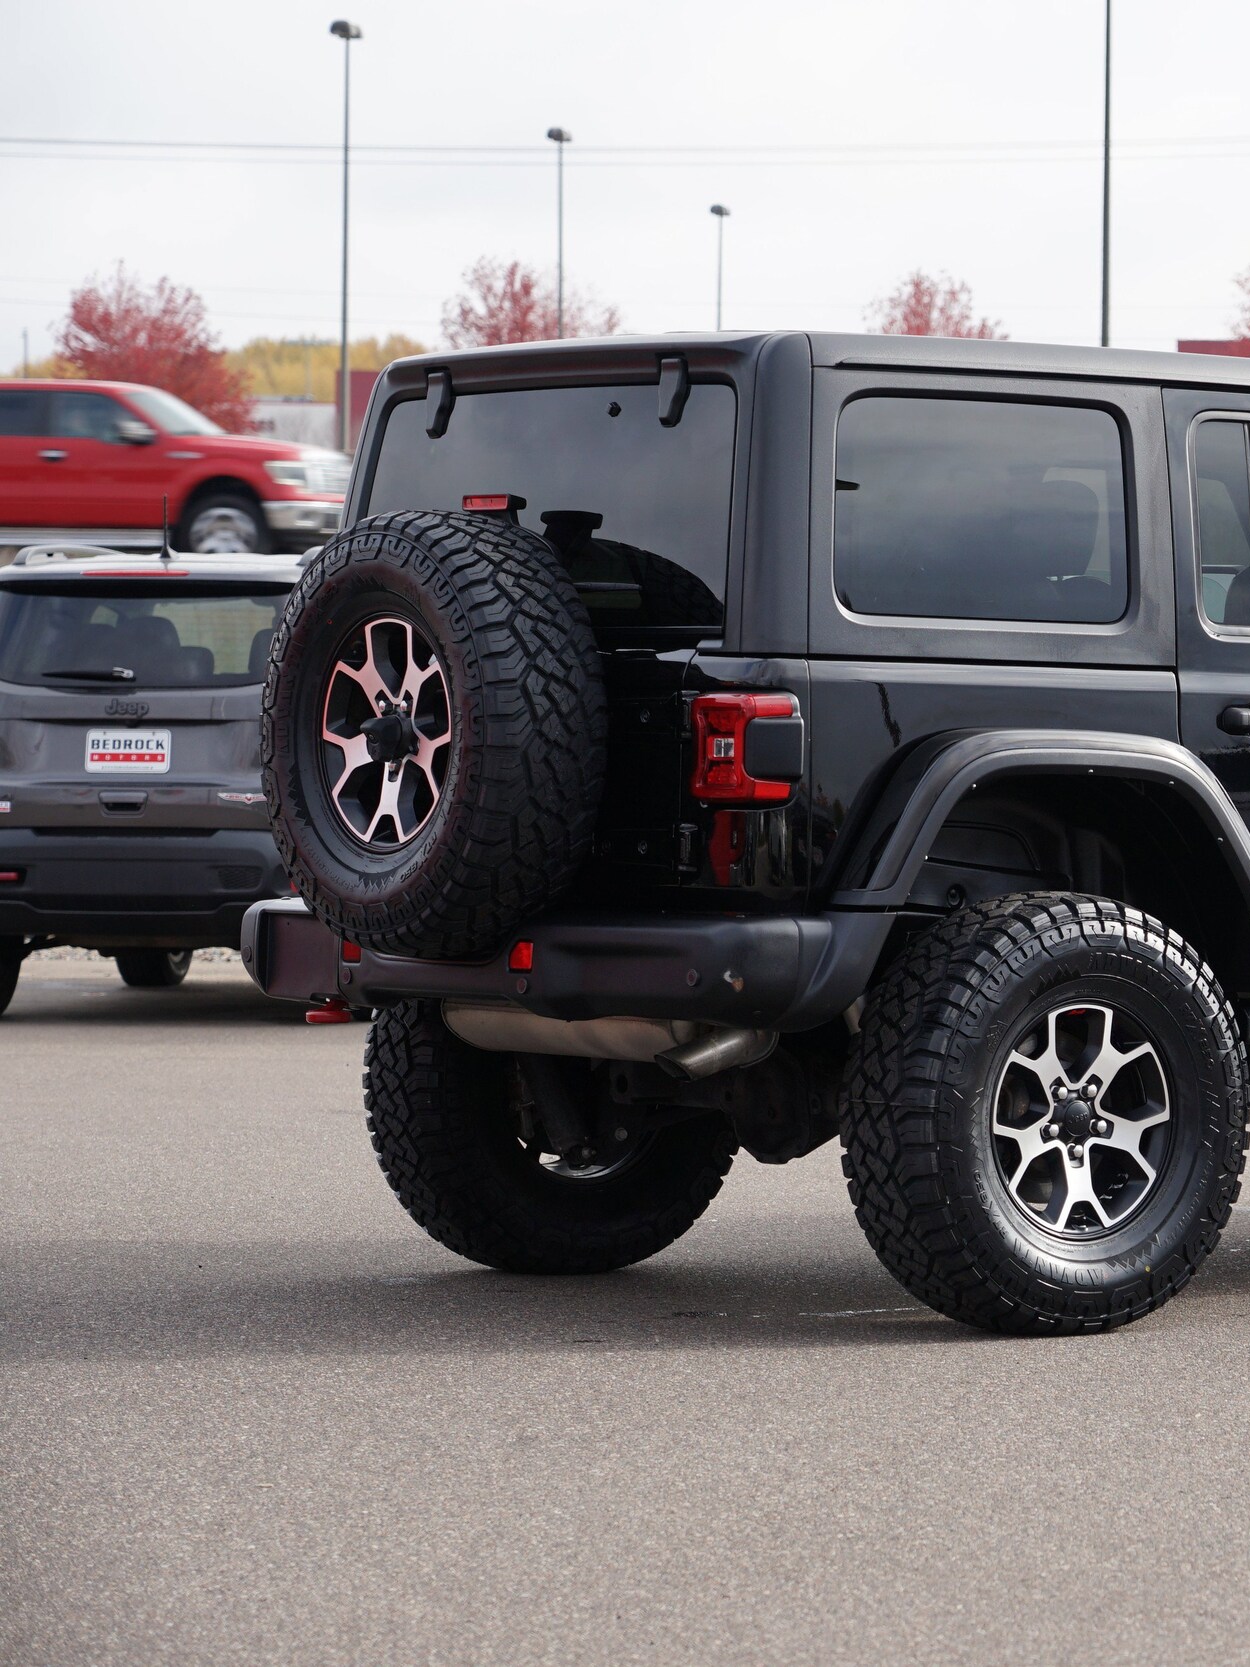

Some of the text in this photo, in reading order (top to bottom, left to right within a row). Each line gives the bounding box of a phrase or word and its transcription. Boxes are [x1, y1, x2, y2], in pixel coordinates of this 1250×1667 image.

[105, 699, 149, 718] Jeep
[91, 739, 165, 750] BEDROCK
[92, 754, 163, 762] MOTORS
